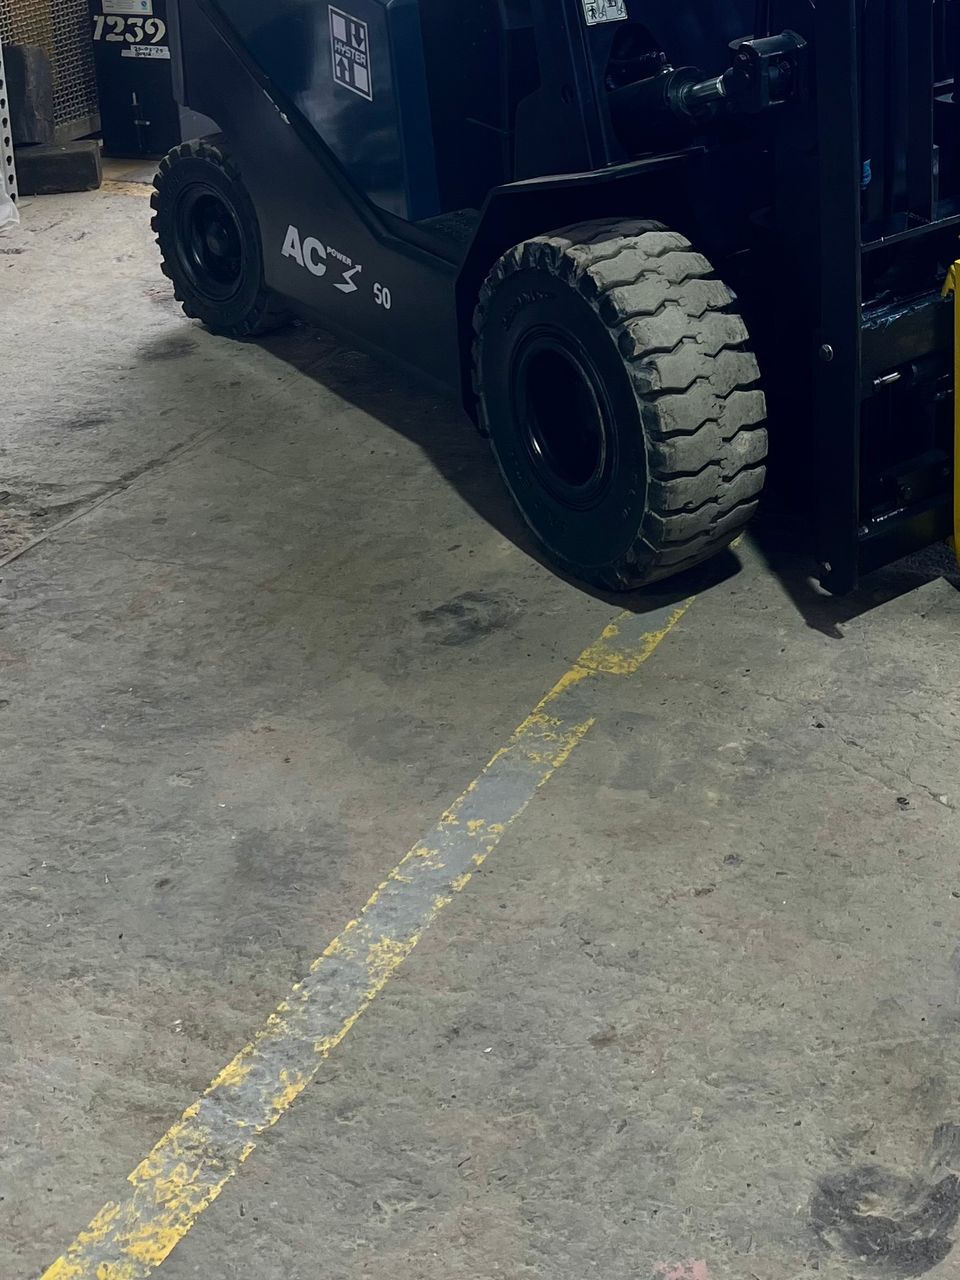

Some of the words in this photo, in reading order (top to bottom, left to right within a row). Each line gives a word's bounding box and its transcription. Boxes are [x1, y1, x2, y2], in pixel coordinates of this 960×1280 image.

[335, 40, 367, 66] HYSTER
[281, 224, 327, 277] AC
[326, 245, 352, 266] POWER
[373, 282, 391, 310] 50
